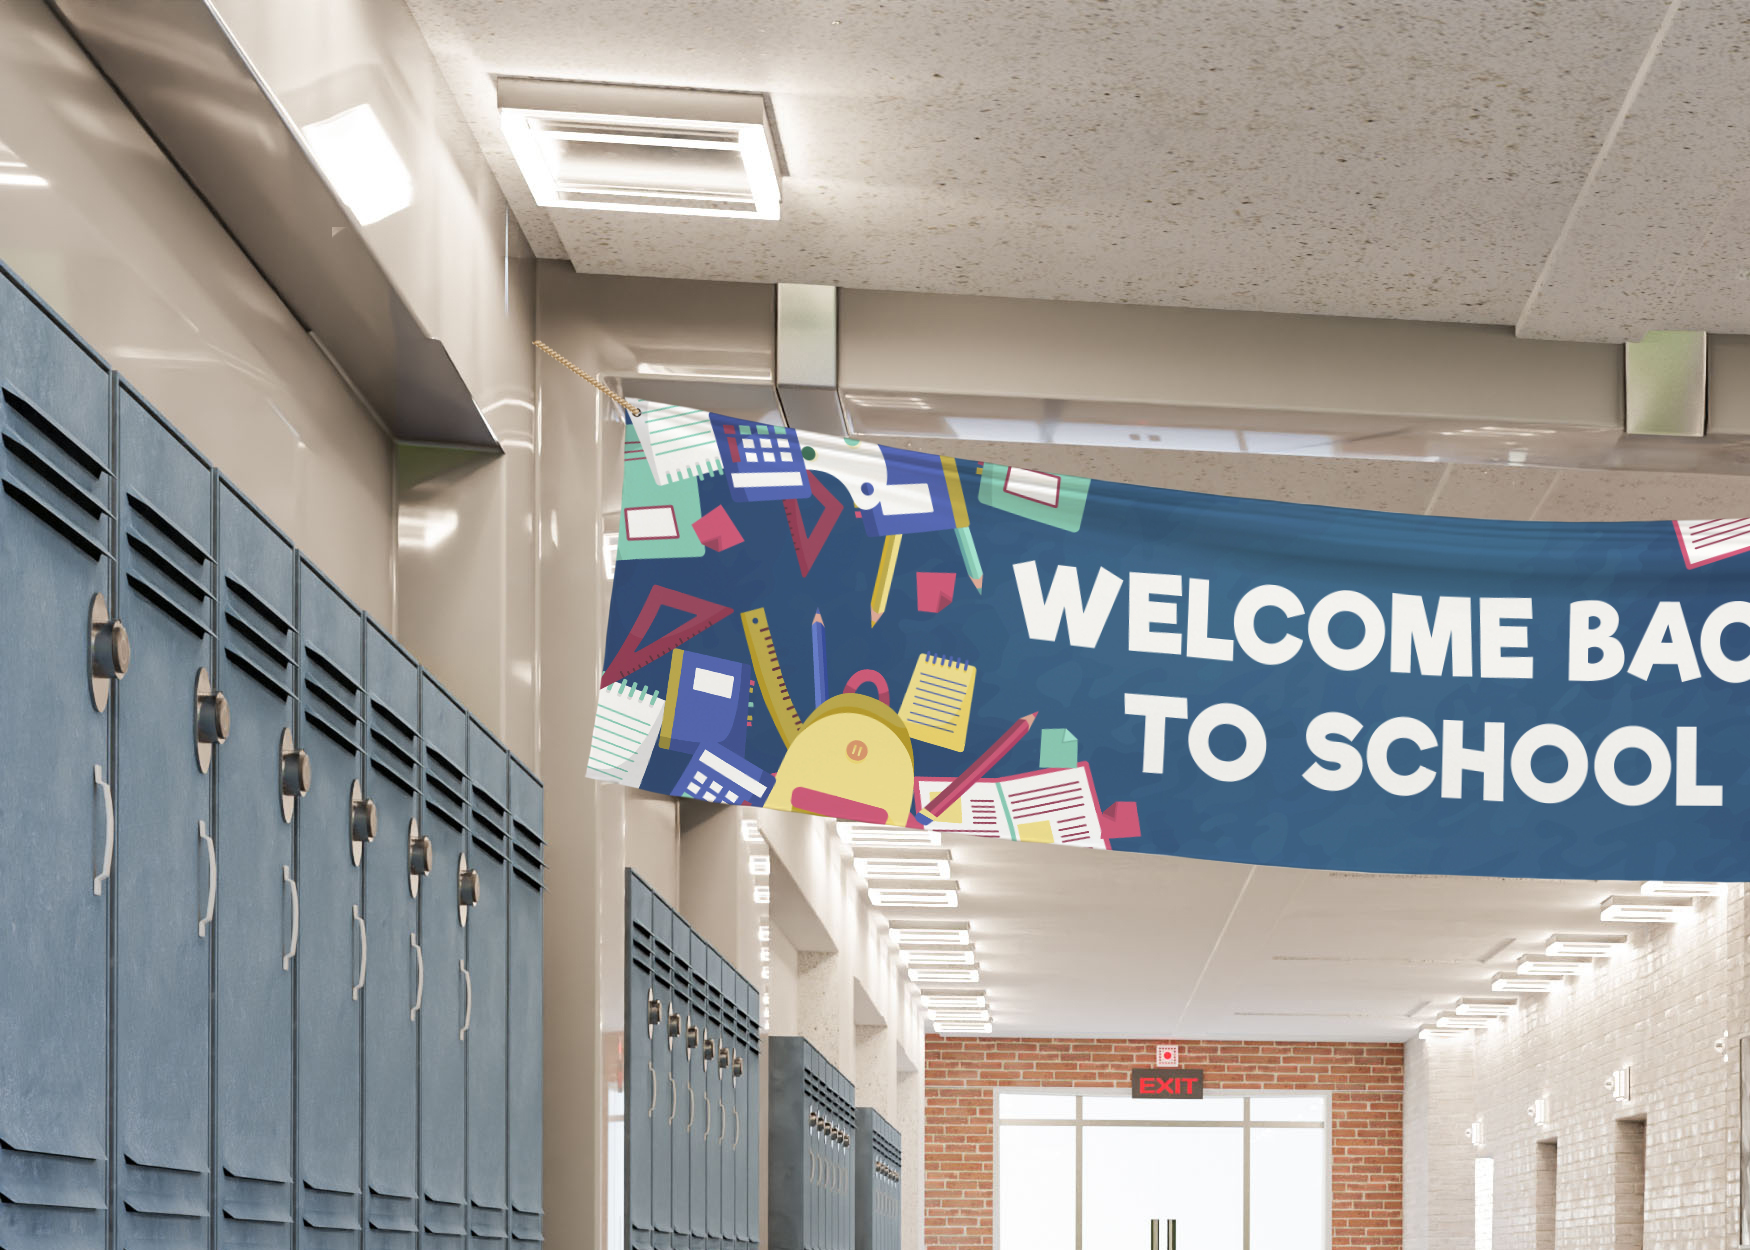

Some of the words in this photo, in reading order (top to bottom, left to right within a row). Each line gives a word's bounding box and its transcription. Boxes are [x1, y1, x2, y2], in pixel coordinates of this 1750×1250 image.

[1013, 559, 1534, 680] WELCOME
[1123, 692, 1267, 783] TO
[1301, 711, 1724, 807] SCHOOL
[1139, 1077, 1199, 1095] EXIT
